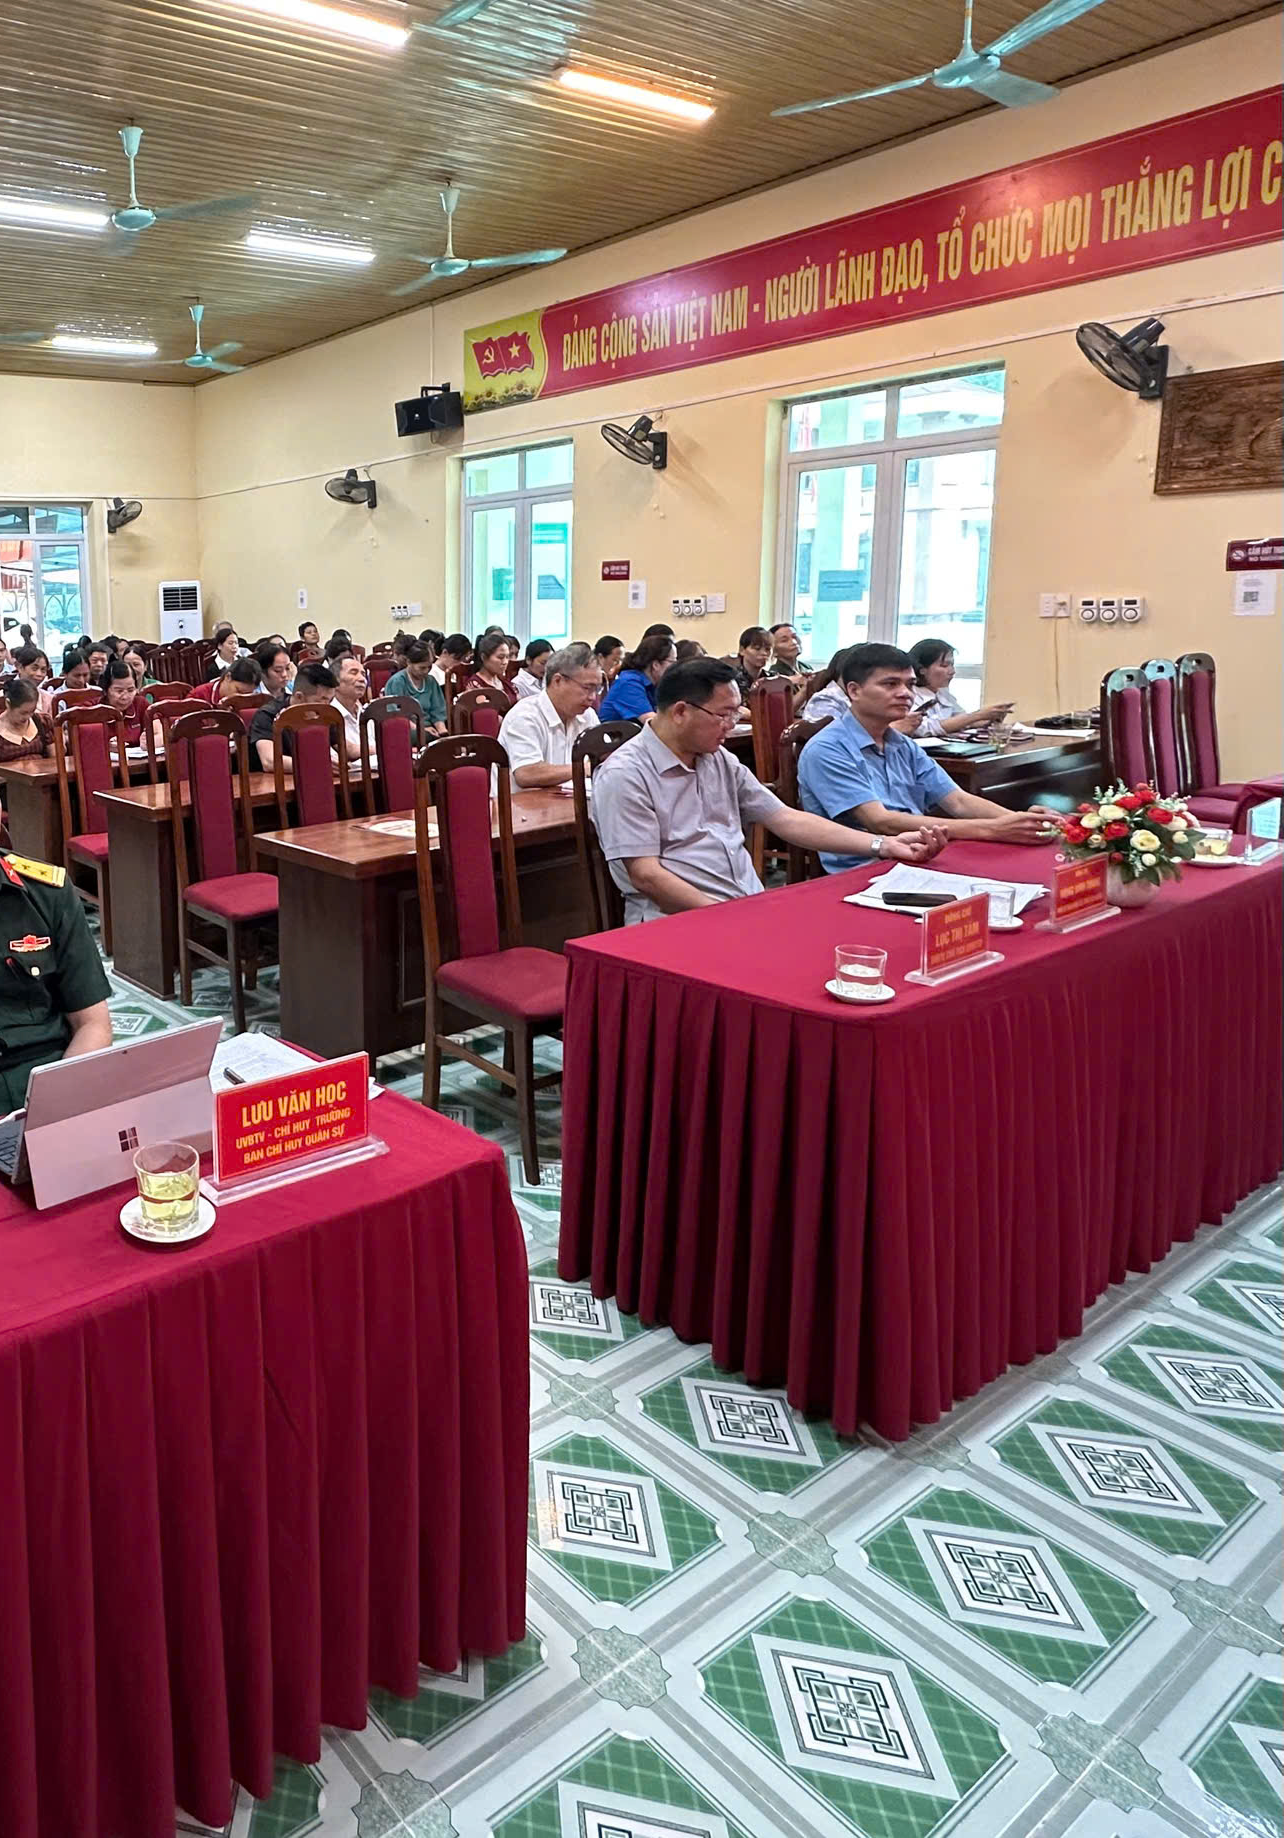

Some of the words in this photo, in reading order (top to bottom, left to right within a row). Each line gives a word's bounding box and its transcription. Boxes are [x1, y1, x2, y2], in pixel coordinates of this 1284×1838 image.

[562, 314, 598, 371] ĐẢNG
[601, 312, 637, 369] CỘNG
[641, 291, 670, 353] SẢN
[675, 290, 706, 351] VIỆT
[711, 285, 748, 336] NAM
[764, 256, 820, 324] NGƯỜI
[825, 249, 876, 309] LÃNH
[881, 238, 928, 304] ĐẠO,
[936, 205, 966, 283] TỔ
[970, 198, 1034, 275] CHỨC
[1041, 192, 1092, 264] MỌI
[1101, 155, 1194, 244] THẮNG
[1202, 145, 1252, 229] LỢI
[241, 1099, 274, 1128] LƯU
[278, 1089, 311, 1117] VĂN
[315, 1081, 347, 1108] HỌC
[235, 1131, 266, 1149] UVBTV
[292, 1118, 311, 1133] HUY
[243, 1147, 264, 1164] BAN
[284, 1137, 303, 1153] HUY
[304, 1130, 330, 1146] QUÂN
[331, 1123, 346, 1138] SỰ
